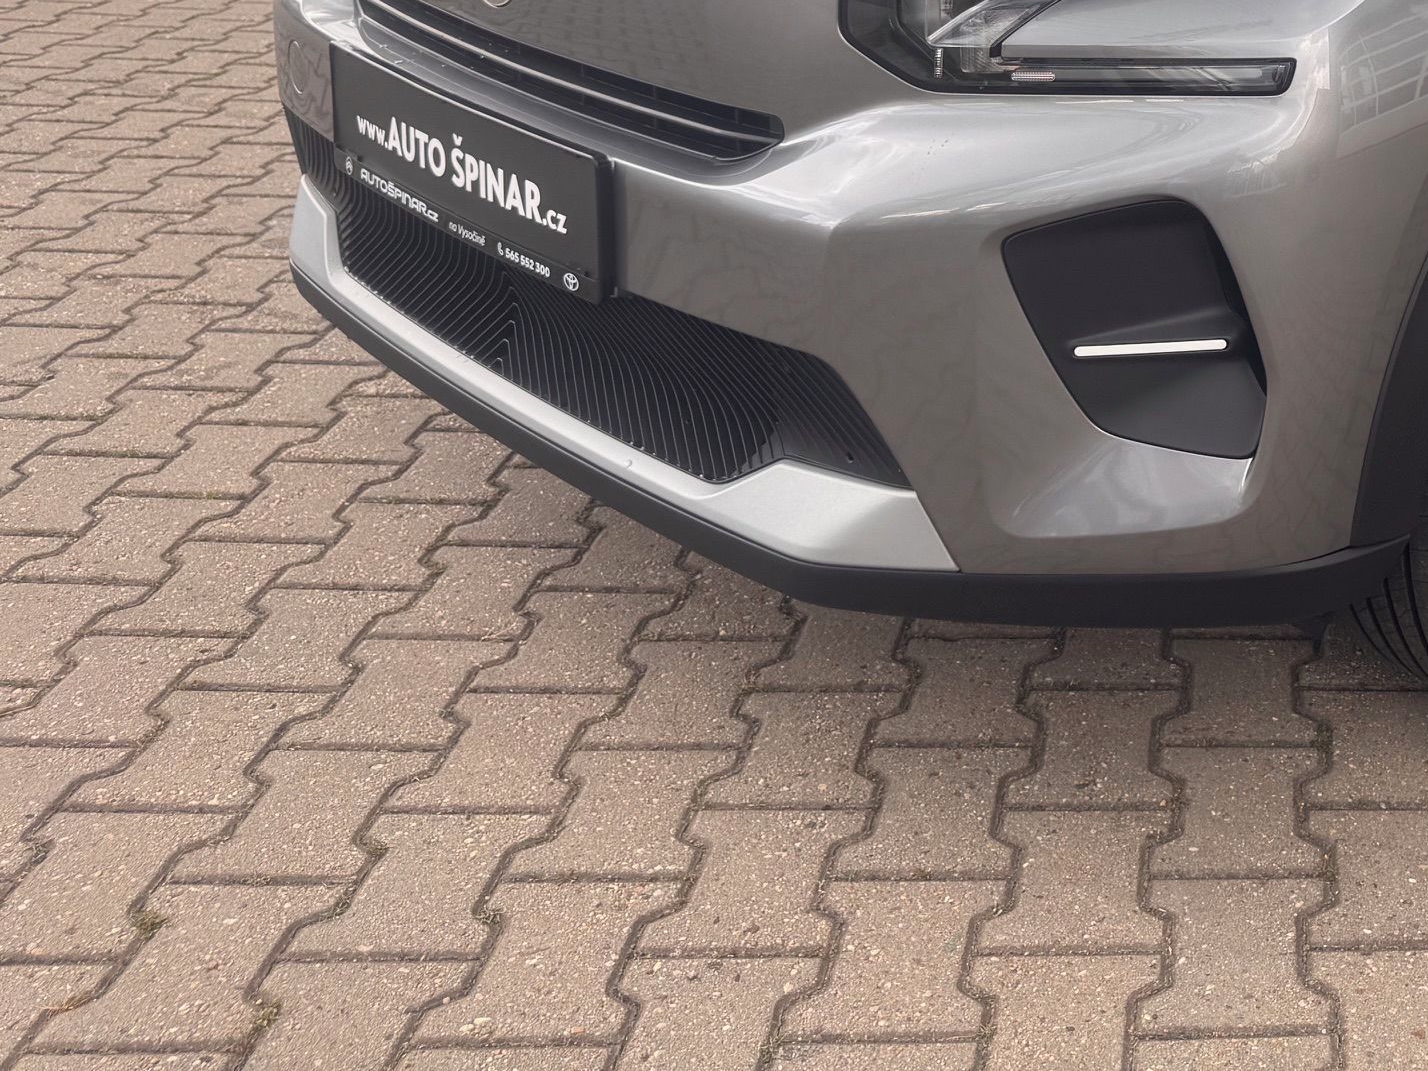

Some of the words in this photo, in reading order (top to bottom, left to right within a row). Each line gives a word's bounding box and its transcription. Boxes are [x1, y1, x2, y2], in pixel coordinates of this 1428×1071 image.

[356, 115, 446, 177] www.AUTO
[451, 133, 567, 234] ŠPINAR.cz
[360, 168, 439, 222] AUTOŠPINAR.cz
[505, 247, 520, 263] 565
[520, 254, 535, 271] 552
[535, 261, 550, 278] 300
